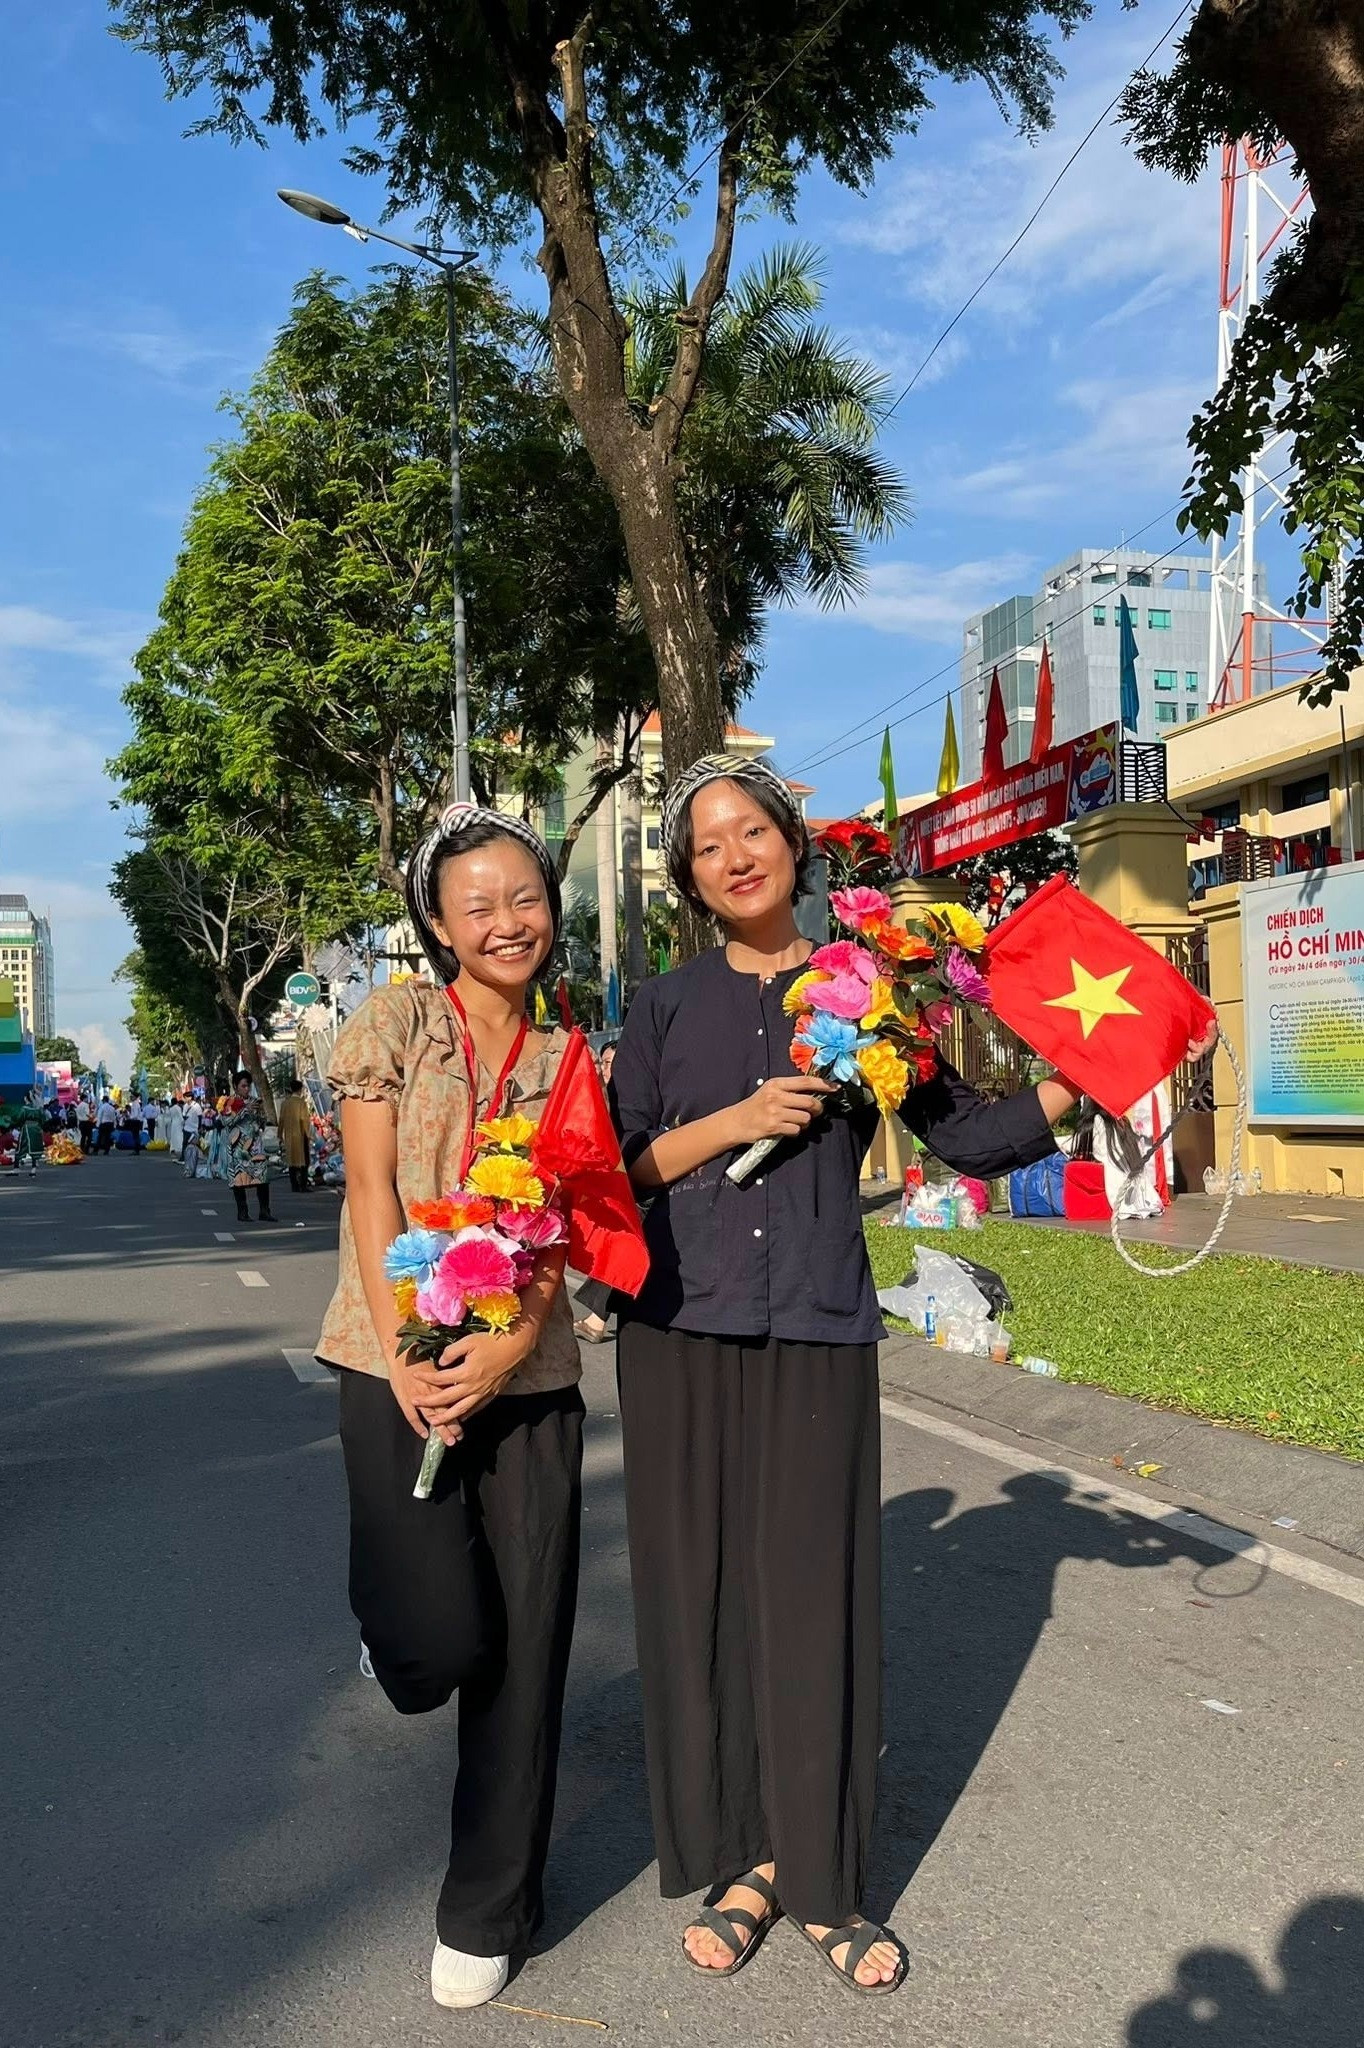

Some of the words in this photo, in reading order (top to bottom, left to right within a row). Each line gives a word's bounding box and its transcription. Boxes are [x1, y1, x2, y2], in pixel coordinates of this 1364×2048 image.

[1267, 907, 1297, 931] CHIẾN
[1299, 907, 1324, 928] DỊCH
[1268, 930, 1293, 961] HỒ
[1298, 928, 1330, 957] CHÍ
[1280, 963, 1296, 974] ngày
[1297, 962, 1313, 971] 26/4
[1314, 959, 1328, 969] đến
[1329, 958, 1347, 969] ngày
[289, 986, 310, 995] BIDV
